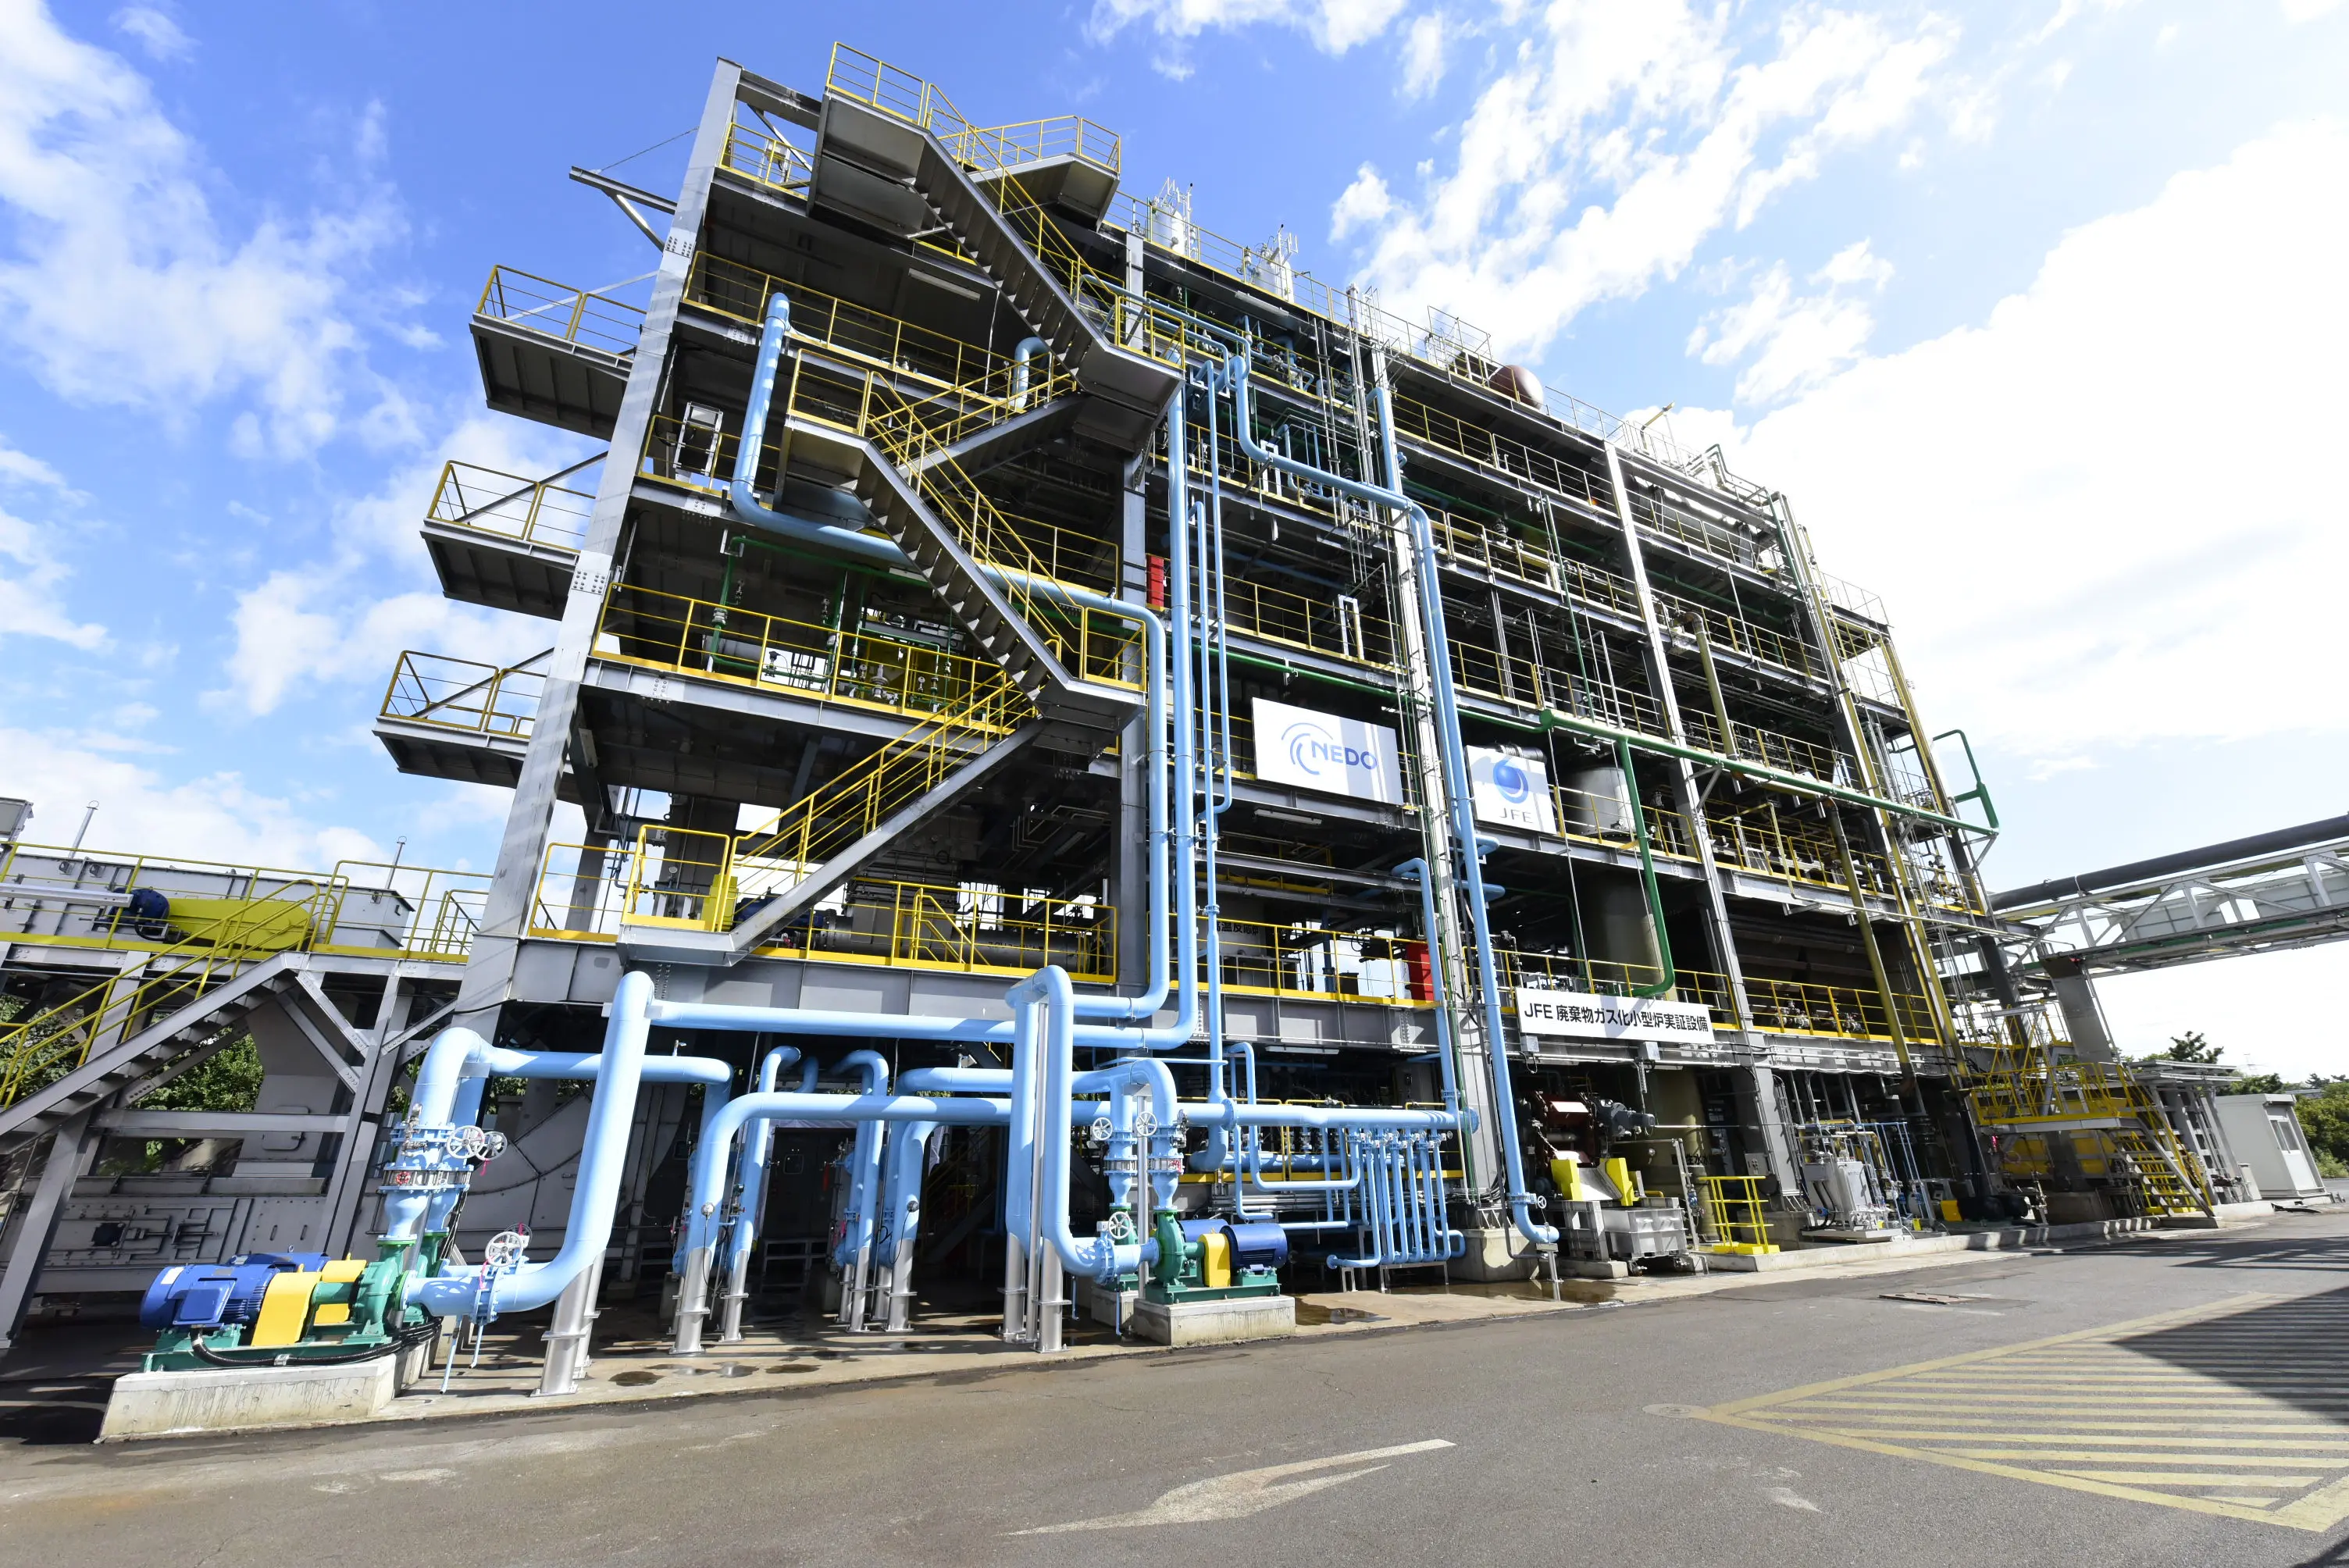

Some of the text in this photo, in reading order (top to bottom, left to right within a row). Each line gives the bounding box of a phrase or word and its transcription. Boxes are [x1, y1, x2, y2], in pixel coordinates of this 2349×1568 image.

[1311, 739, 1377, 769] NEDO
[1499, 807, 1533, 823] JFE
[1524, 1003, 1709, 1032] JFE 廃棄物ガス化小型炉実証設備
